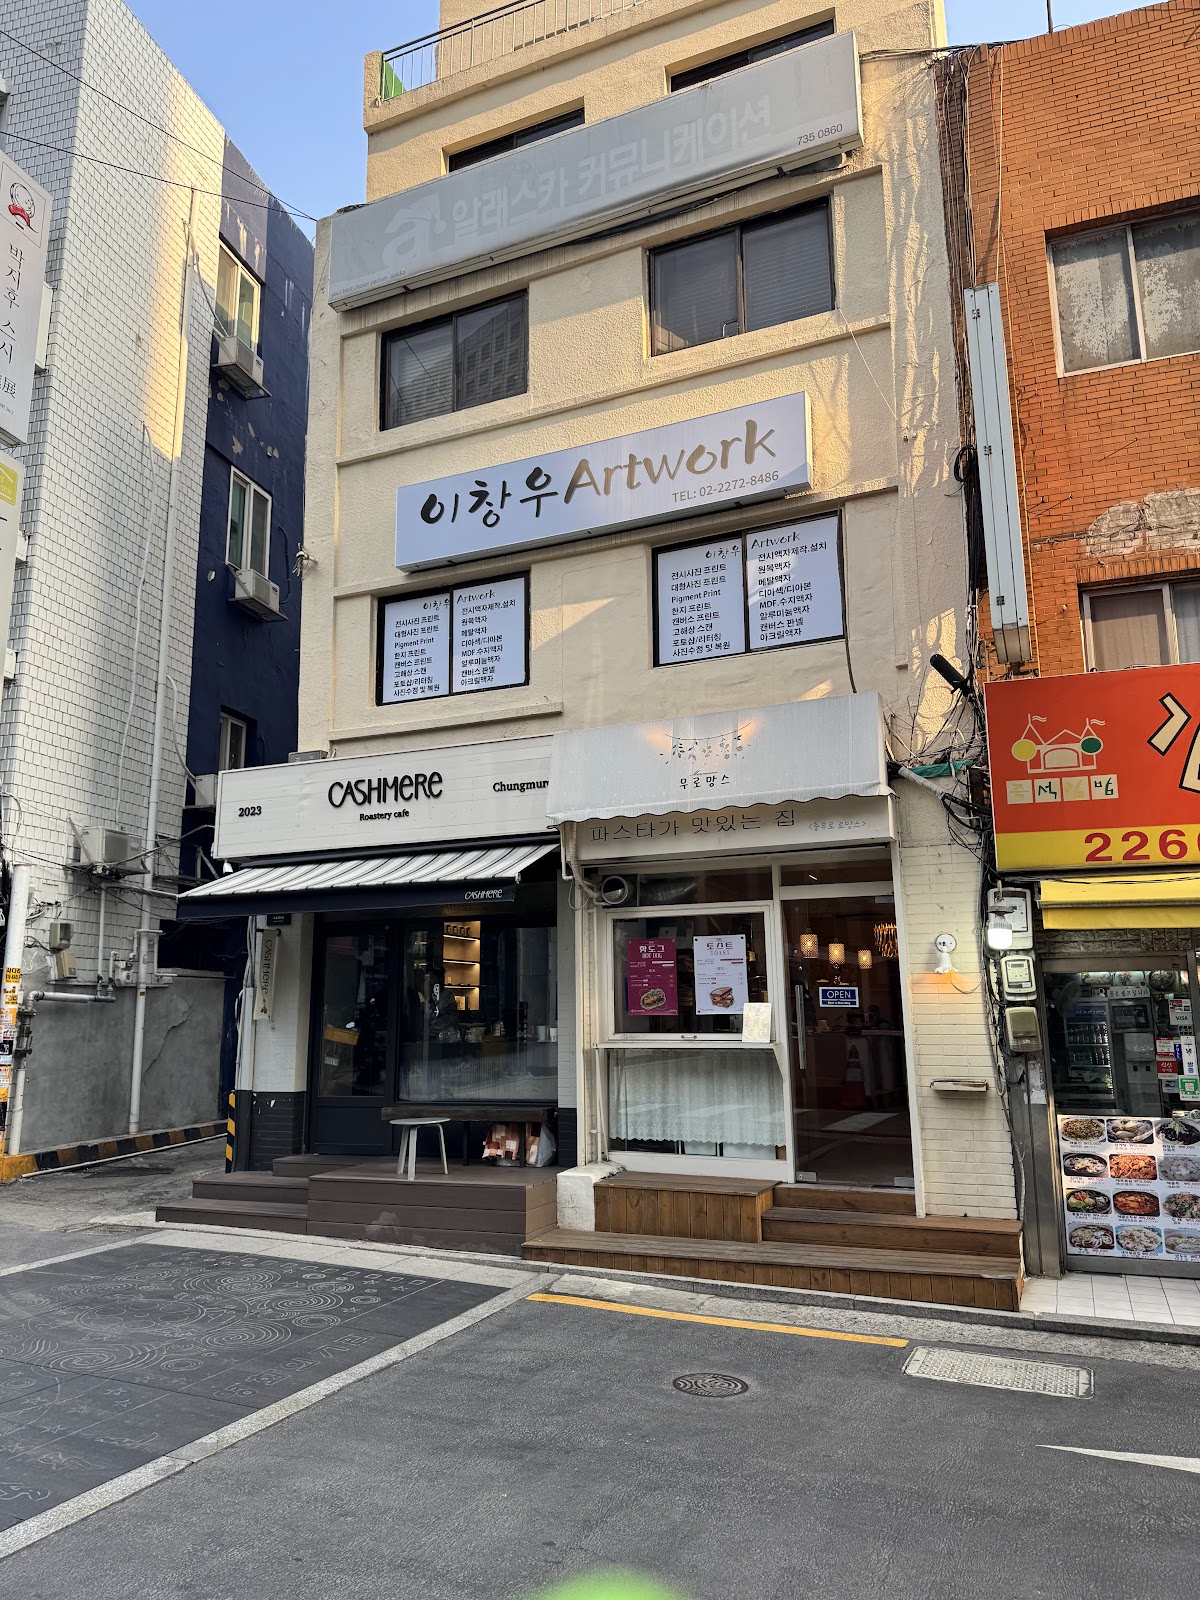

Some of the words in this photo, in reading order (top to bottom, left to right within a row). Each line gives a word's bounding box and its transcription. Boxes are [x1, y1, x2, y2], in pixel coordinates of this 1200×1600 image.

[797, 132, 815, 146] 735
[817, 123, 843, 139] 0860
[451, 174, 568, 238] 알래스카
[578, 95, 771, 192] 커뮤니케이션
[5, 242, 25, 309] 박지후
[342, 285, 354, 294] best
[353, 281, 370, 291] choice
[0, 320, 16, 365] 스시
[421, 466, 559, 528] 이창우
[564, 419, 777, 505] Artwork
[672, 490, 697, 503] TEL:
[699, 470, 779, 498] 02-2272-8486
[751, 531, 800, 550] Artwork
[705, 545, 740, 559] 이창우
[758, 541, 827, 562] 전시액자제작.설치
[671, 568, 702, 580] 전시사진
[703, 563, 727, 575] 프린트
[758, 561, 791, 574] 원목액자
[671, 580, 702, 592] 대형사진
[703, 575, 727, 587] 프린트
[758, 573, 791, 586] 메탈액자
[423, 598, 450, 610] 이창우
[456, 589, 496, 604] Artwork
[671, 593, 702, 604] Pigment
[703, 589, 721, 598] Print
[671, 606, 687, 616] 한지
[688, 602, 711, 613] 프린트
[759, 605, 810, 621] 알루미늄액자
[395, 617, 420, 628] 전시사진
[421, 614, 440, 624] 프린트
[461, 615, 487, 626] 원목액자
[672, 615, 695, 626] 캔버스
[696, 611, 720, 622] 프린트
[760, 620, 785, 632] 캔버스
[786, 616, 804, 628] 판넬
[395, 628, 419, 638] 대형사진
[420, 625, 439, 635] 프린트
[461, 626, 487, 637] 메탈액자
[672, 625, 695, 636] 고해상
[697, 622, 713, 632] 스캔
[760, 628, 802, 641] 아크릴액자
[394, 639, 419, 649] Pigment
[420, 637, 434, 646] Print
[672, 633, 722, 647] 포토샵/리터칭
[394, 651, 407, 660] 한지
[407, 648, 426, 658] 프린트
[672, 644, 703, 657] 사진수정
[706, 643, 713, 653] 및
[714, 640, 730, 651] 복원
[1009, 776, 1115, 802] 즉석김밥
[238, 805, 262, 817] 2023
[359, 811, 392, 822] Roastery
[393, 808, 410, 819] cafe
[590, 819, 680, 842] 파스타가
[691, 813, 761, 835] 맛있는
[775, 809, 795, 828] 집
[1084, 829, 1200, 862] 226
[826, 990, 851, 999] OPEN
